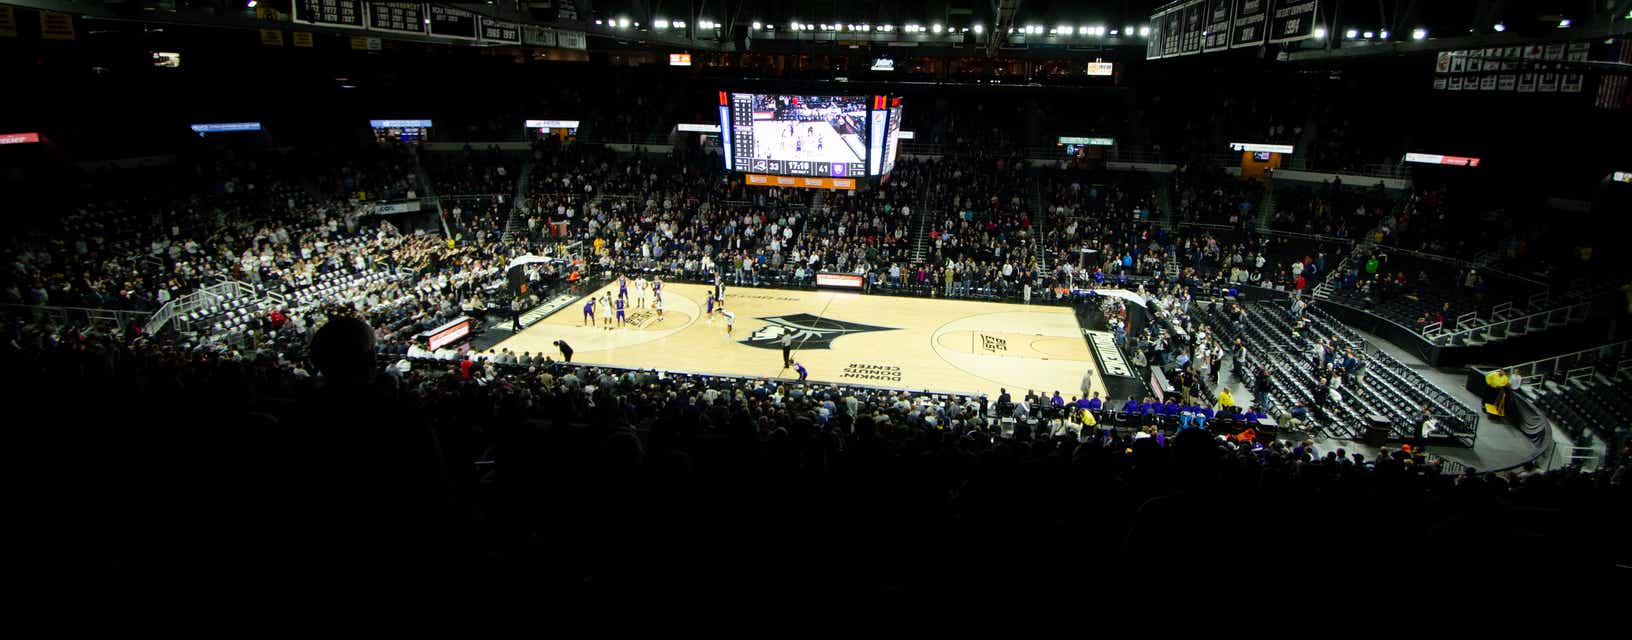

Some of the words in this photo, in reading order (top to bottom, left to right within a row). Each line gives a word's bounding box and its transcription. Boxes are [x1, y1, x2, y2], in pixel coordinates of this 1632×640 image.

[849, 362, 900, 371] CENTER
[844, 368, 902, 376] DONUTS
[840, 373, 902, 382] DUNKIN'
